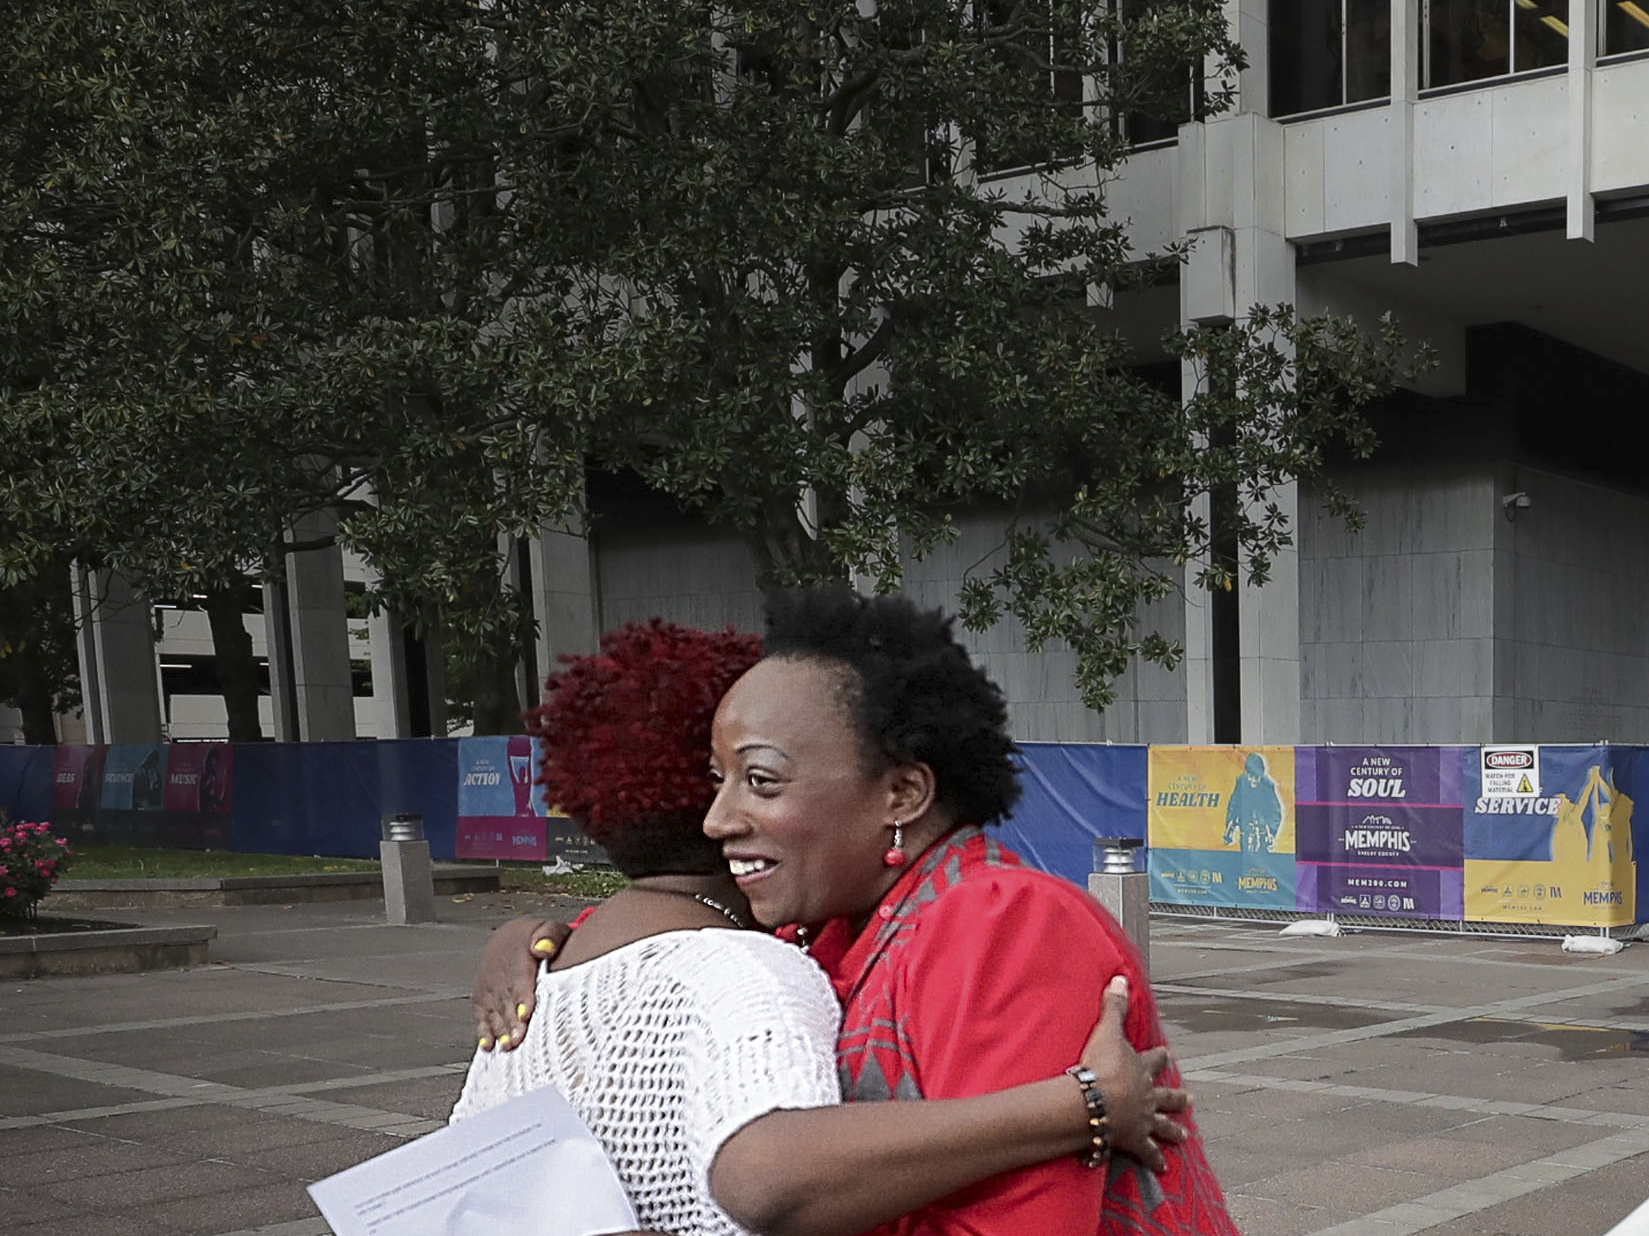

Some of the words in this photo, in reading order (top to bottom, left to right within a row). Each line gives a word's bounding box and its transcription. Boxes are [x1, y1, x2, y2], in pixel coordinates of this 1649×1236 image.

[1362, 758, 1368, 766] A
[1370, 758, 1390, 766] NEW
[1491, 756, 1528, 766] DANGER
[1350, 767, 1389, 776] CENTURY
[1391, 768, 1403, 776] OF
[170, 774, 198, 785] MUSIC
[464, 772, 501, 786] ACTION
[1347, 778, 1406, 798] SOUL
[1156, 792, 1221, 807] HEALTH
[1474, 797, 1562, 815] SERVICE
[1345, 830, 1411, 852] MEMPHIS
[1238, 876, 1278, 892] MEMPHIS
